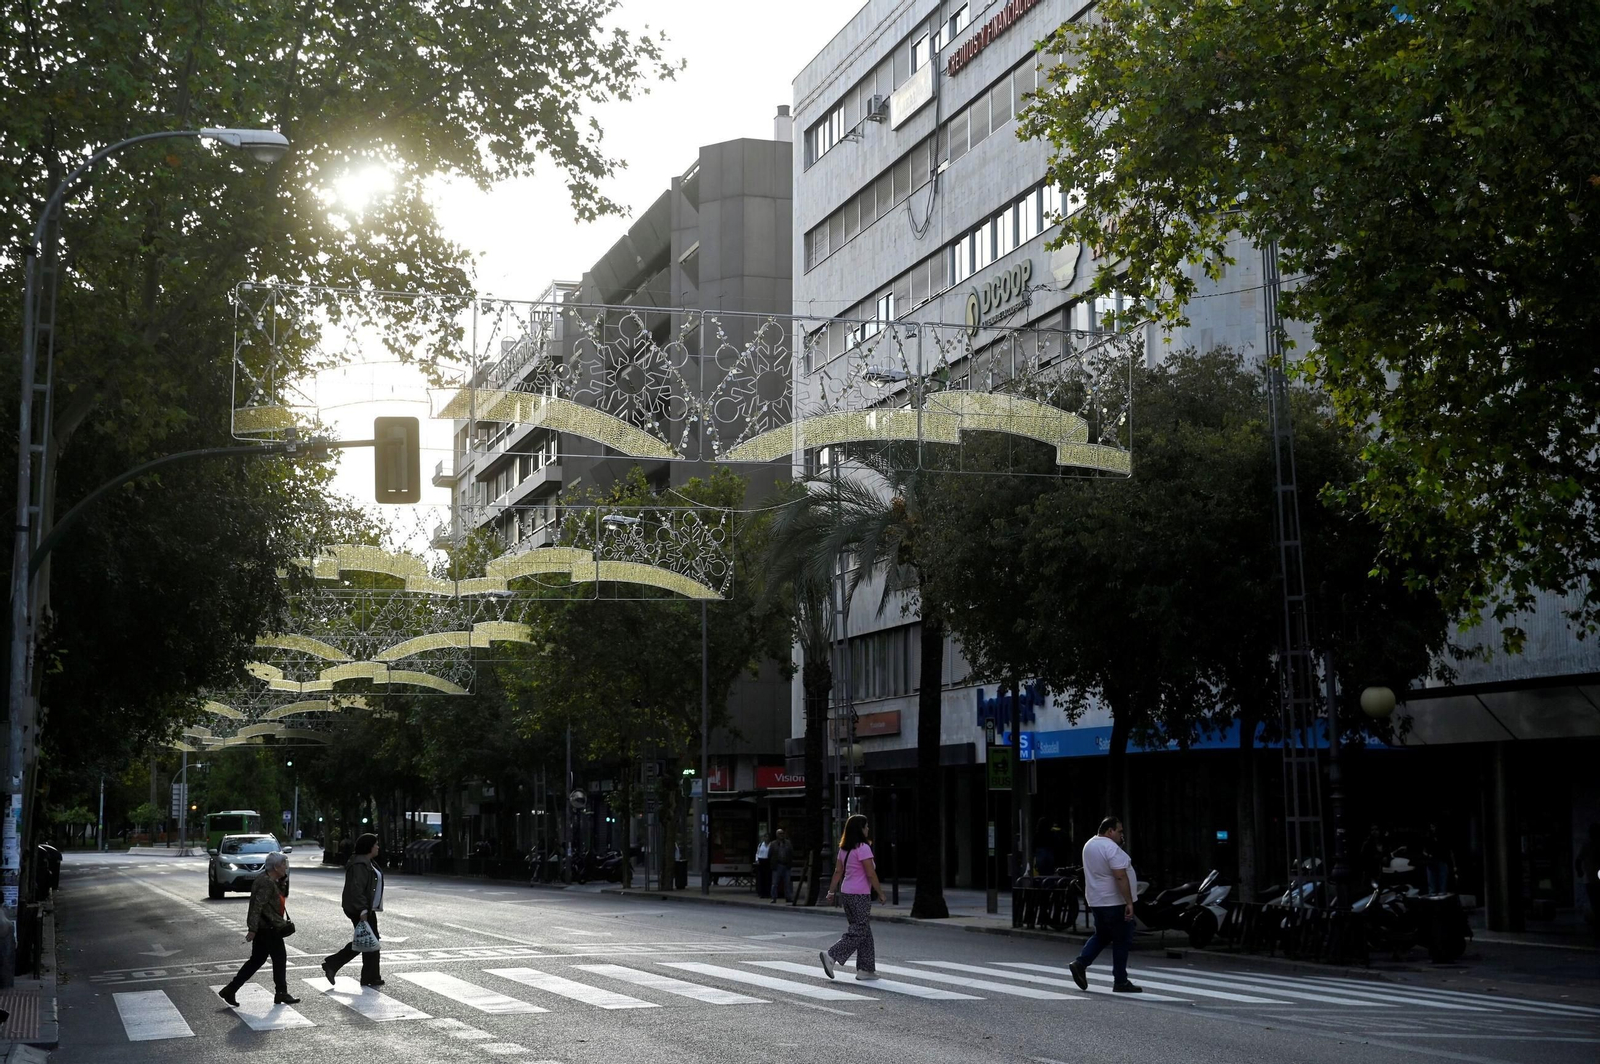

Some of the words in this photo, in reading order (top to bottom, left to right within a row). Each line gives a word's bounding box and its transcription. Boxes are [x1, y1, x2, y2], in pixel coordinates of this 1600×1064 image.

[982, 259, 1032, 314] DCOOP
[991, 776, 1011, 786] BUS
[350, 947, 541, 962] MOTO
